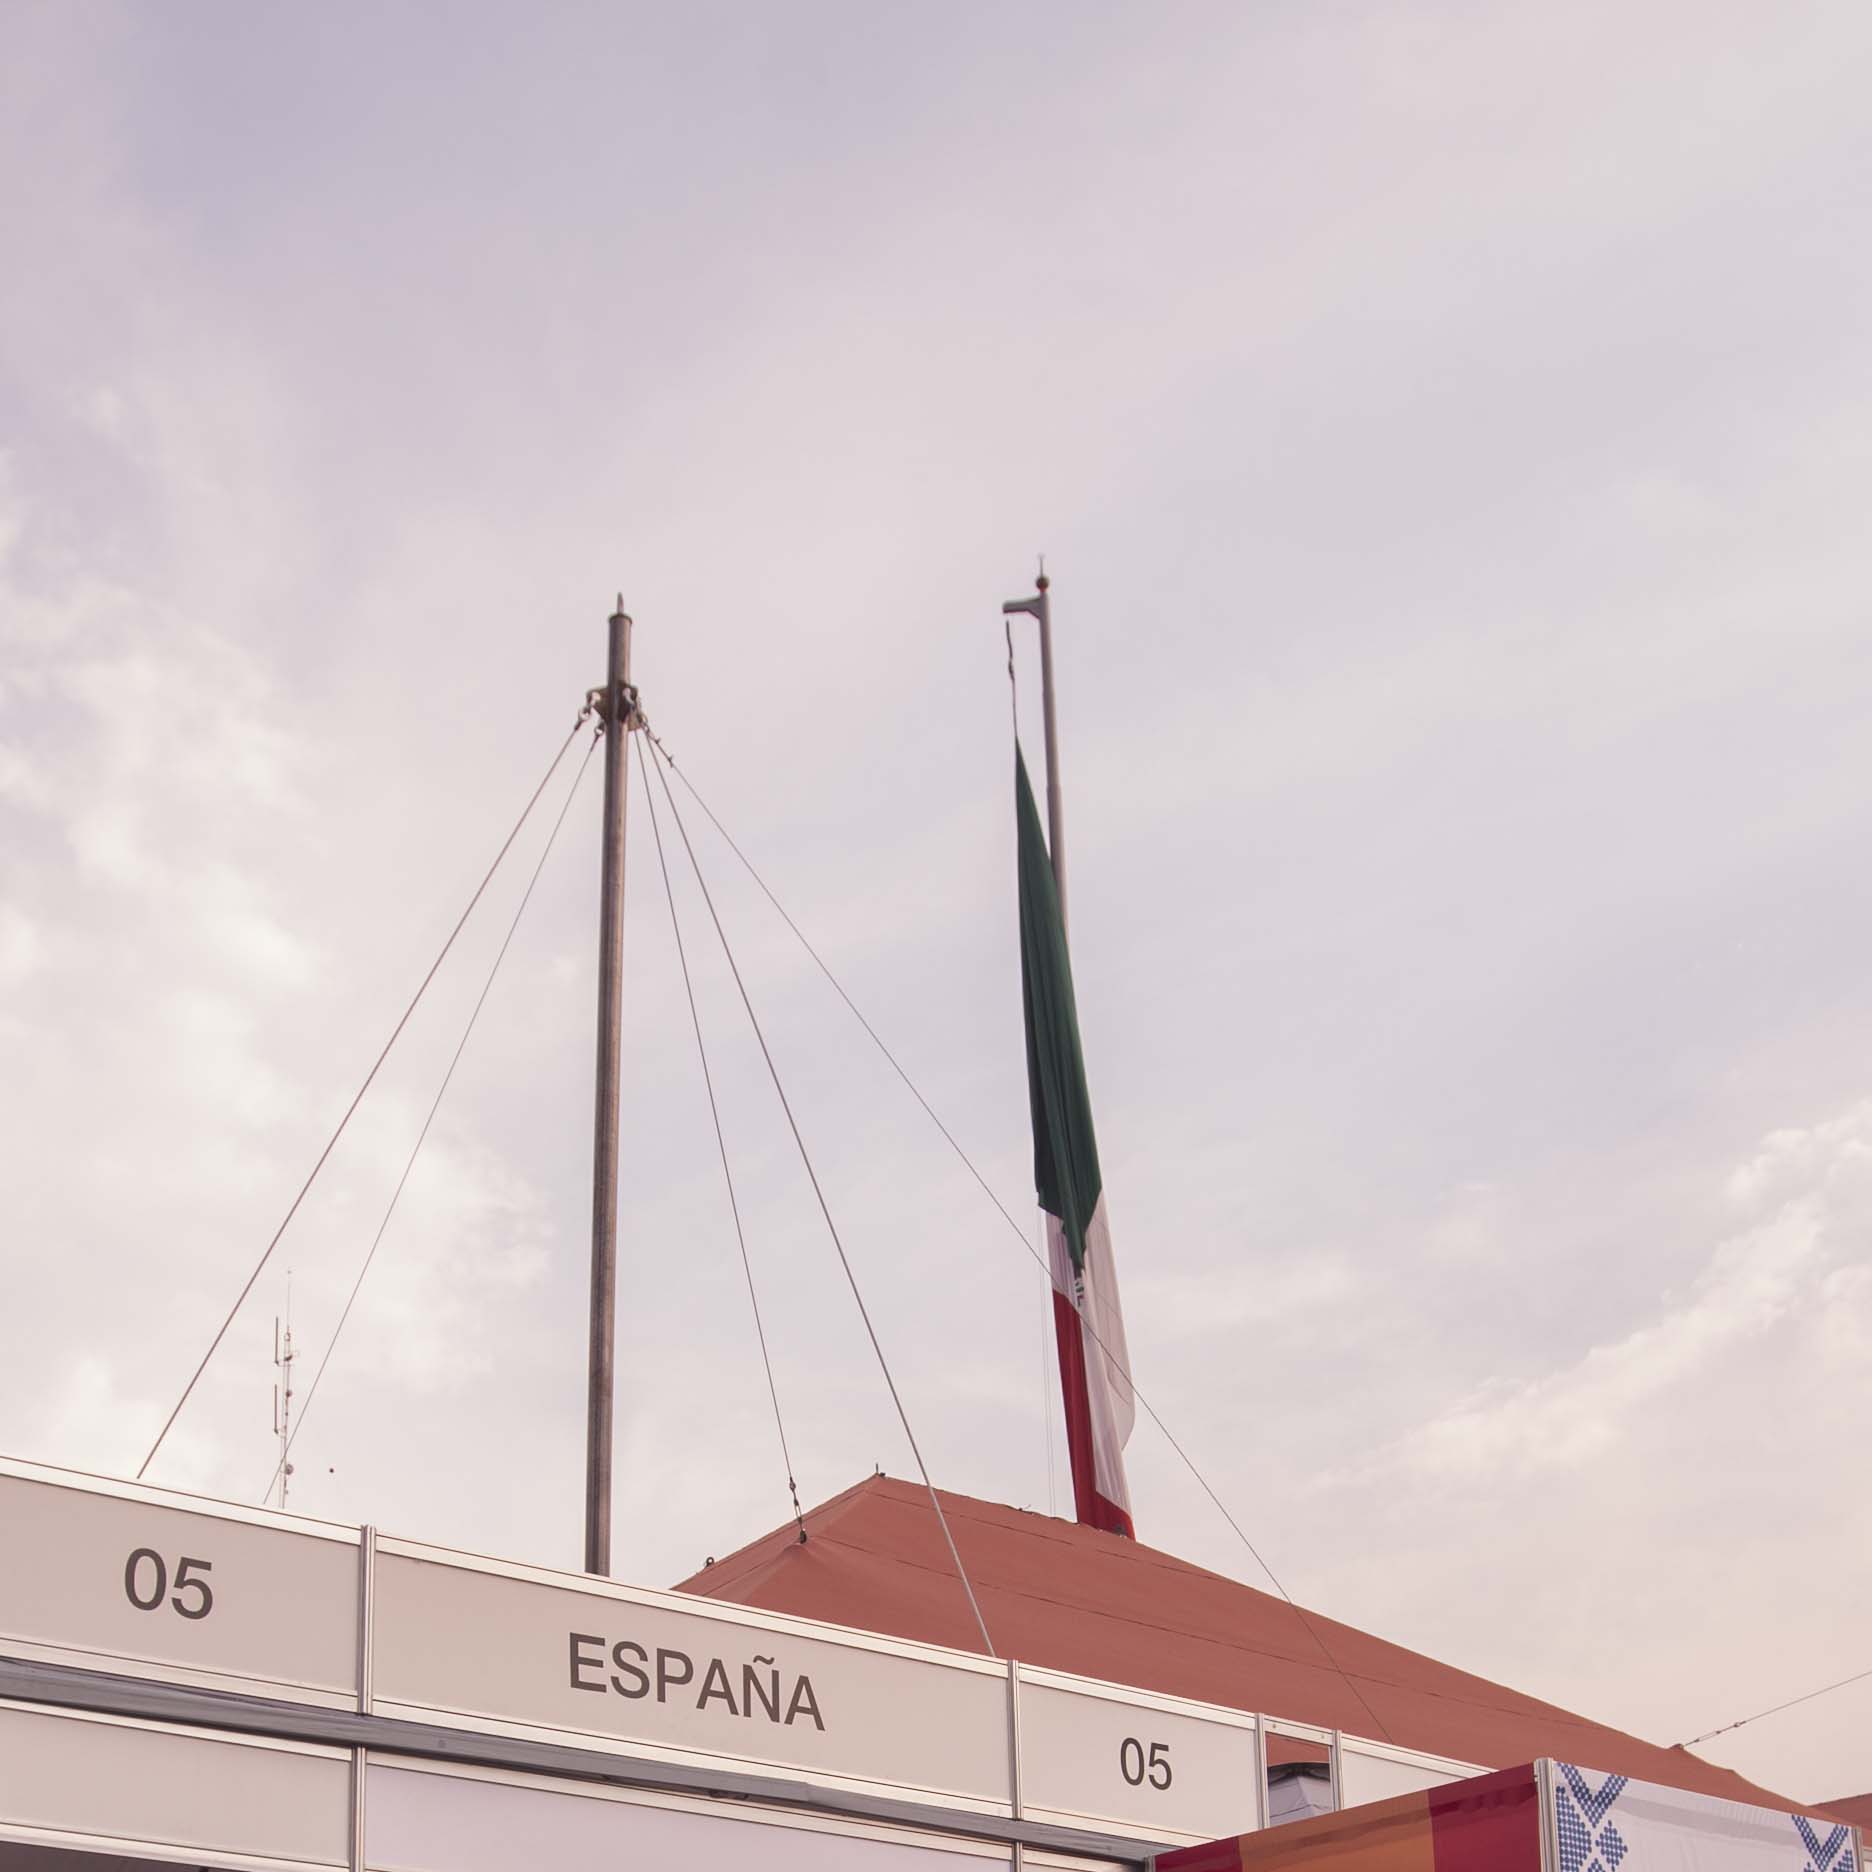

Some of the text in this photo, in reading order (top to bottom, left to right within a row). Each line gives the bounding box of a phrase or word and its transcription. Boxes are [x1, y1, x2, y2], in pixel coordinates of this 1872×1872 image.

[123, 1547, 214, 1620] 05
[568, 1631, 825, 1733] ESPAÑA
[1119, 1737, 1173, 1792] 05
